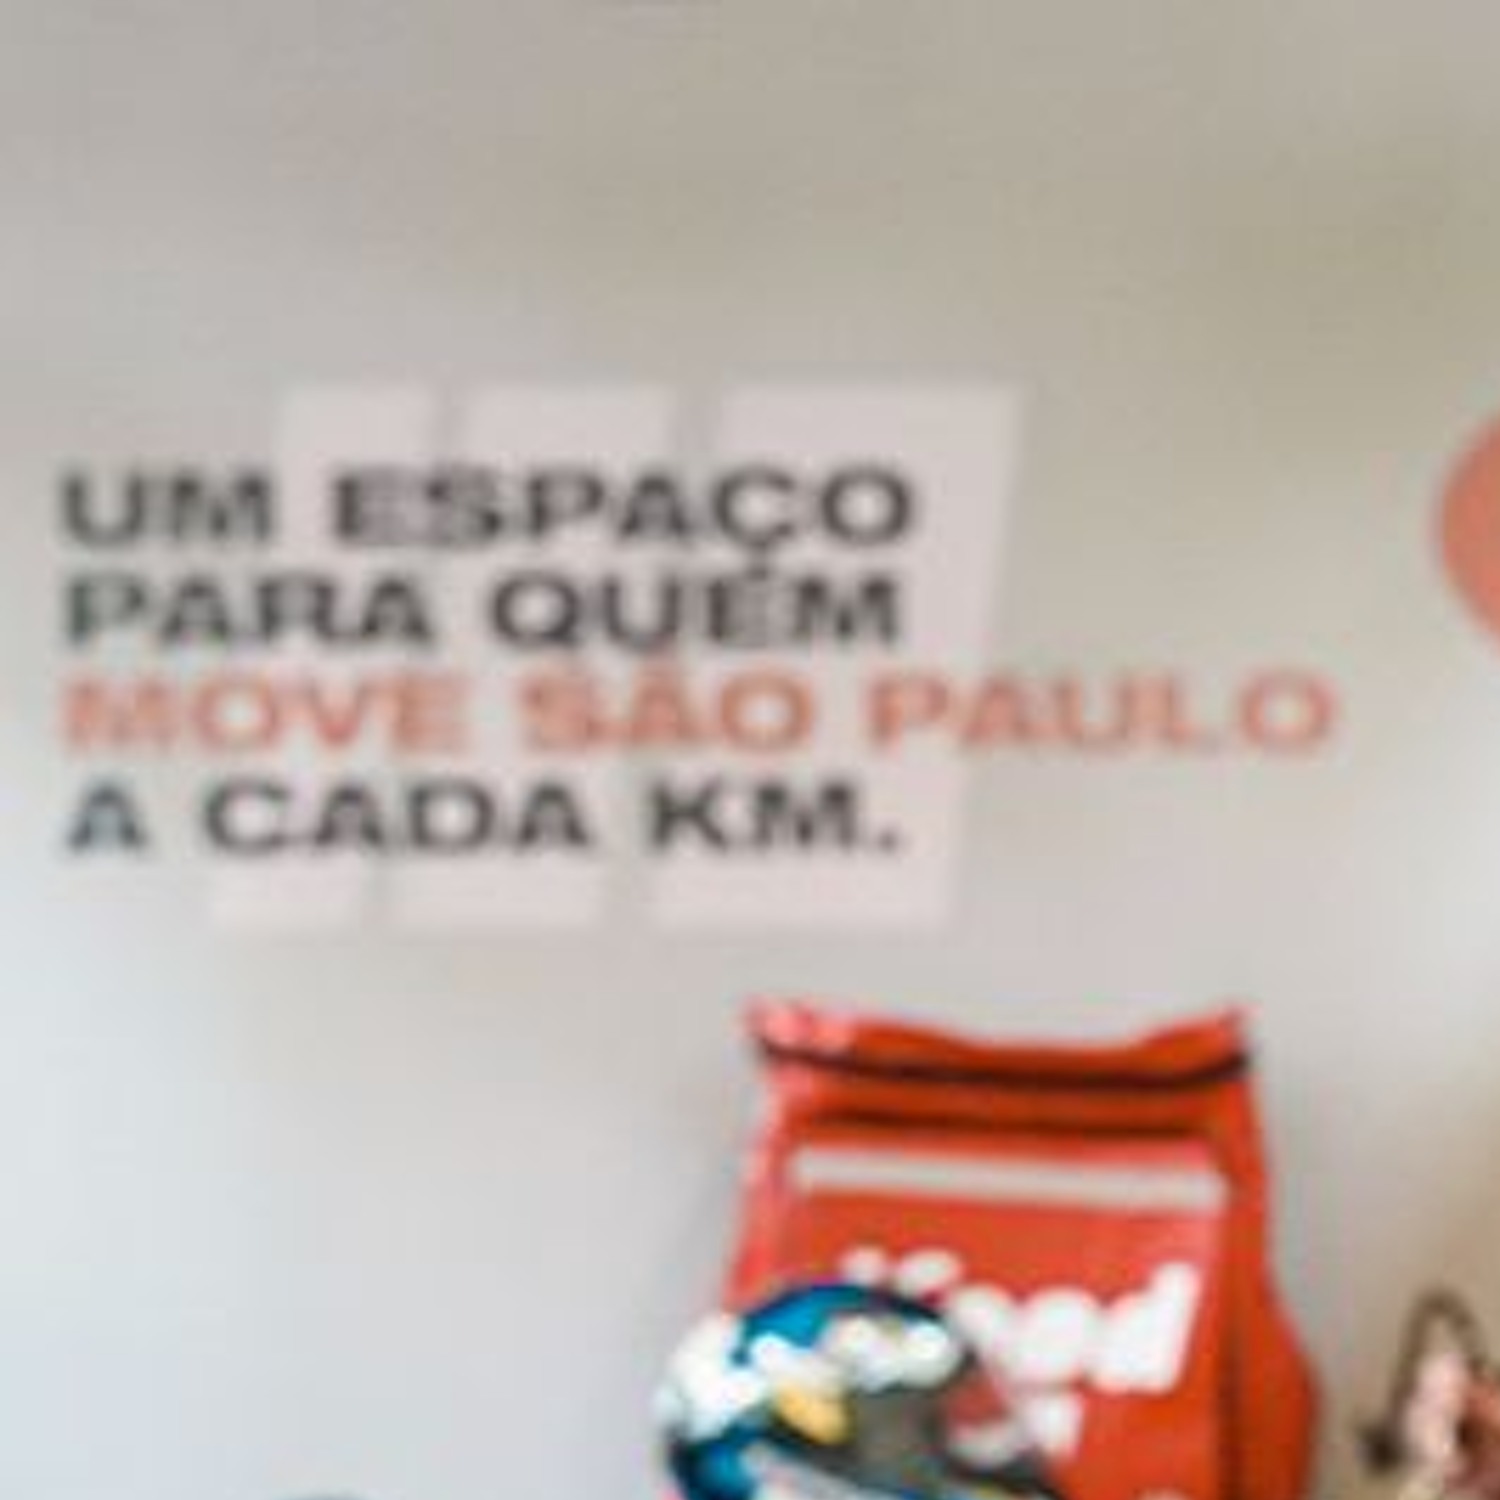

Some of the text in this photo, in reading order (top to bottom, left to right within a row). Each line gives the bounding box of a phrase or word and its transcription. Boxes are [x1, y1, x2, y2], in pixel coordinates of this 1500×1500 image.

[58, 464, 915, 575] UM ESPAÇO
[62, 568, 900, 655] PARA QUEM
[60, 650, 1335, 756] MOVE SÃO PAULO
[66, 778, 902, 856] A CADA KM.
